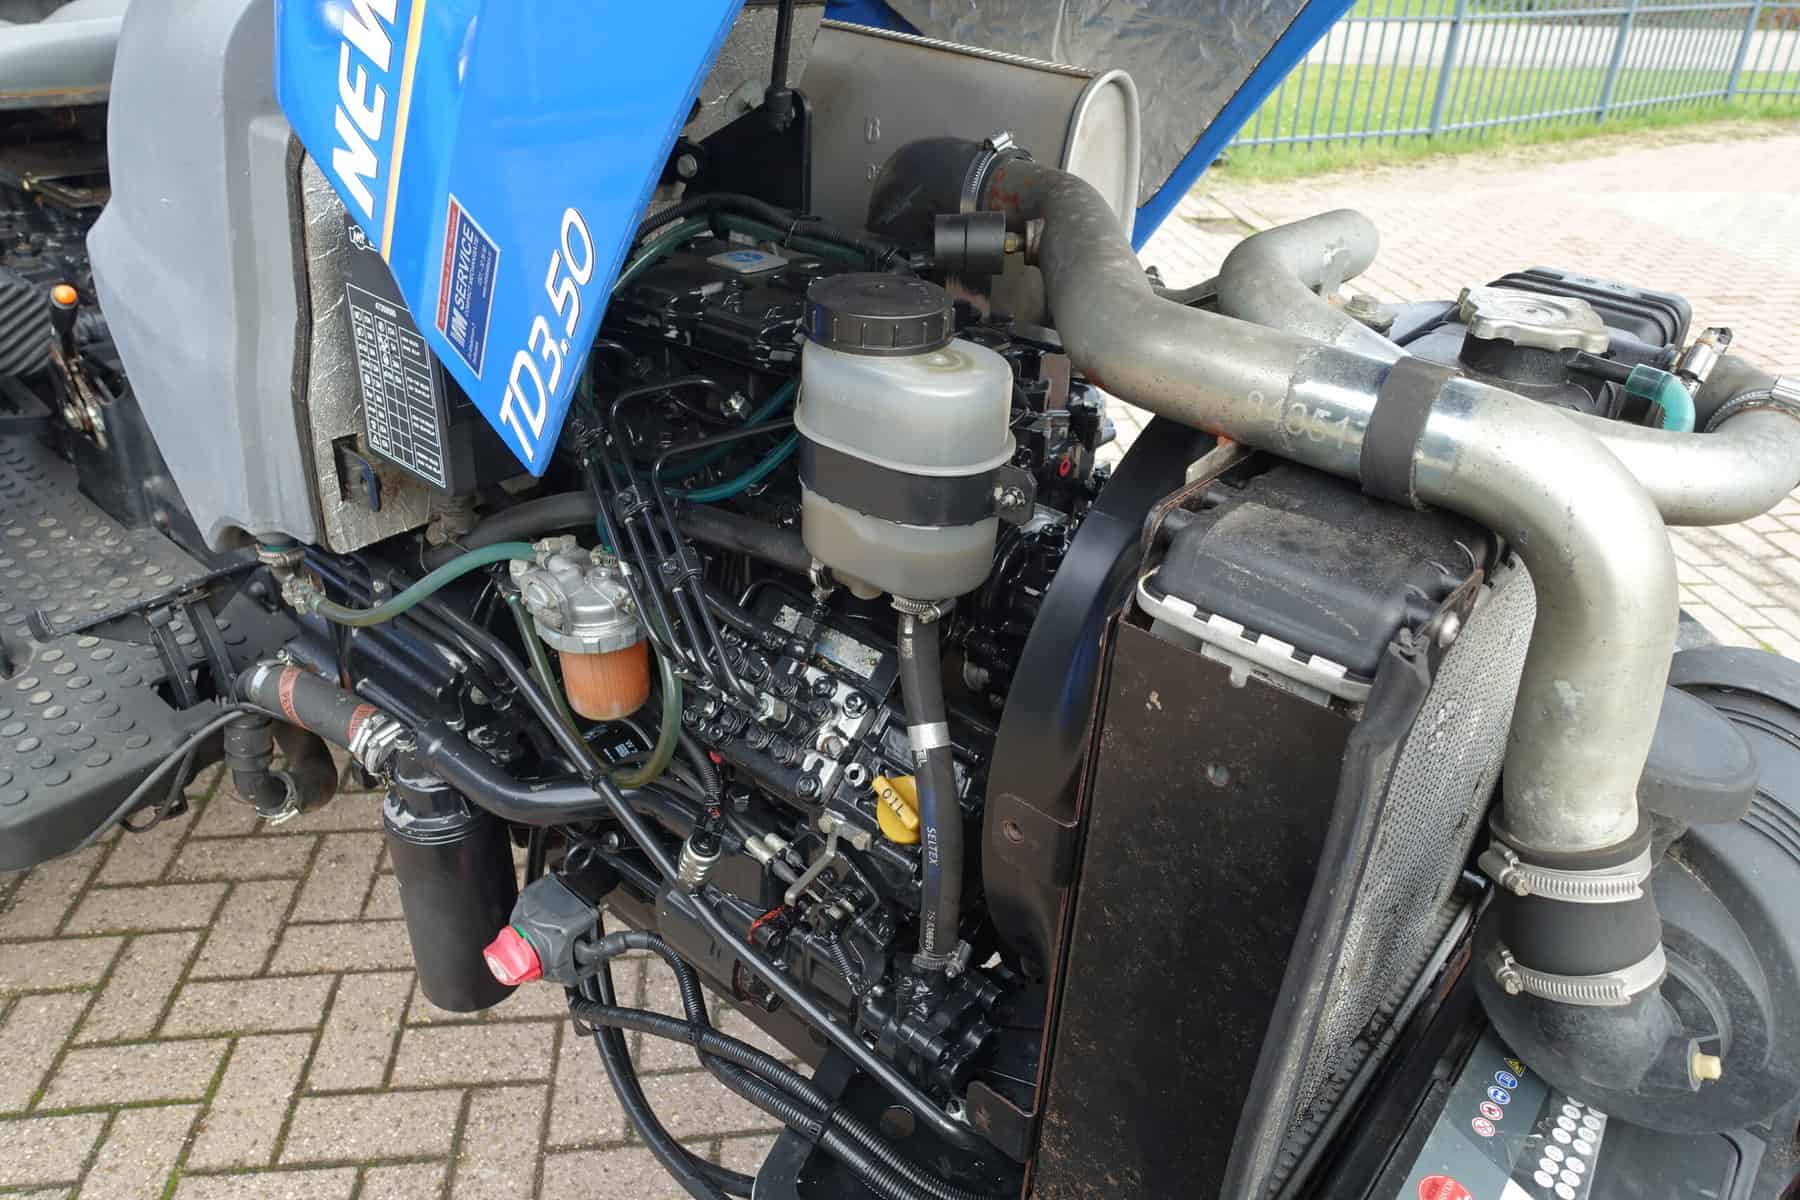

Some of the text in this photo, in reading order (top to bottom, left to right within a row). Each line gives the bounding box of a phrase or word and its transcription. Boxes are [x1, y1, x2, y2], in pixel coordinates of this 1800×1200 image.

[453, 225, 476, 308] SERVICE
[499, 207, 595, 462] TD3.50
[882, 788, 904, 819] OIL
[927, 825, 939, 867] SELTEX
